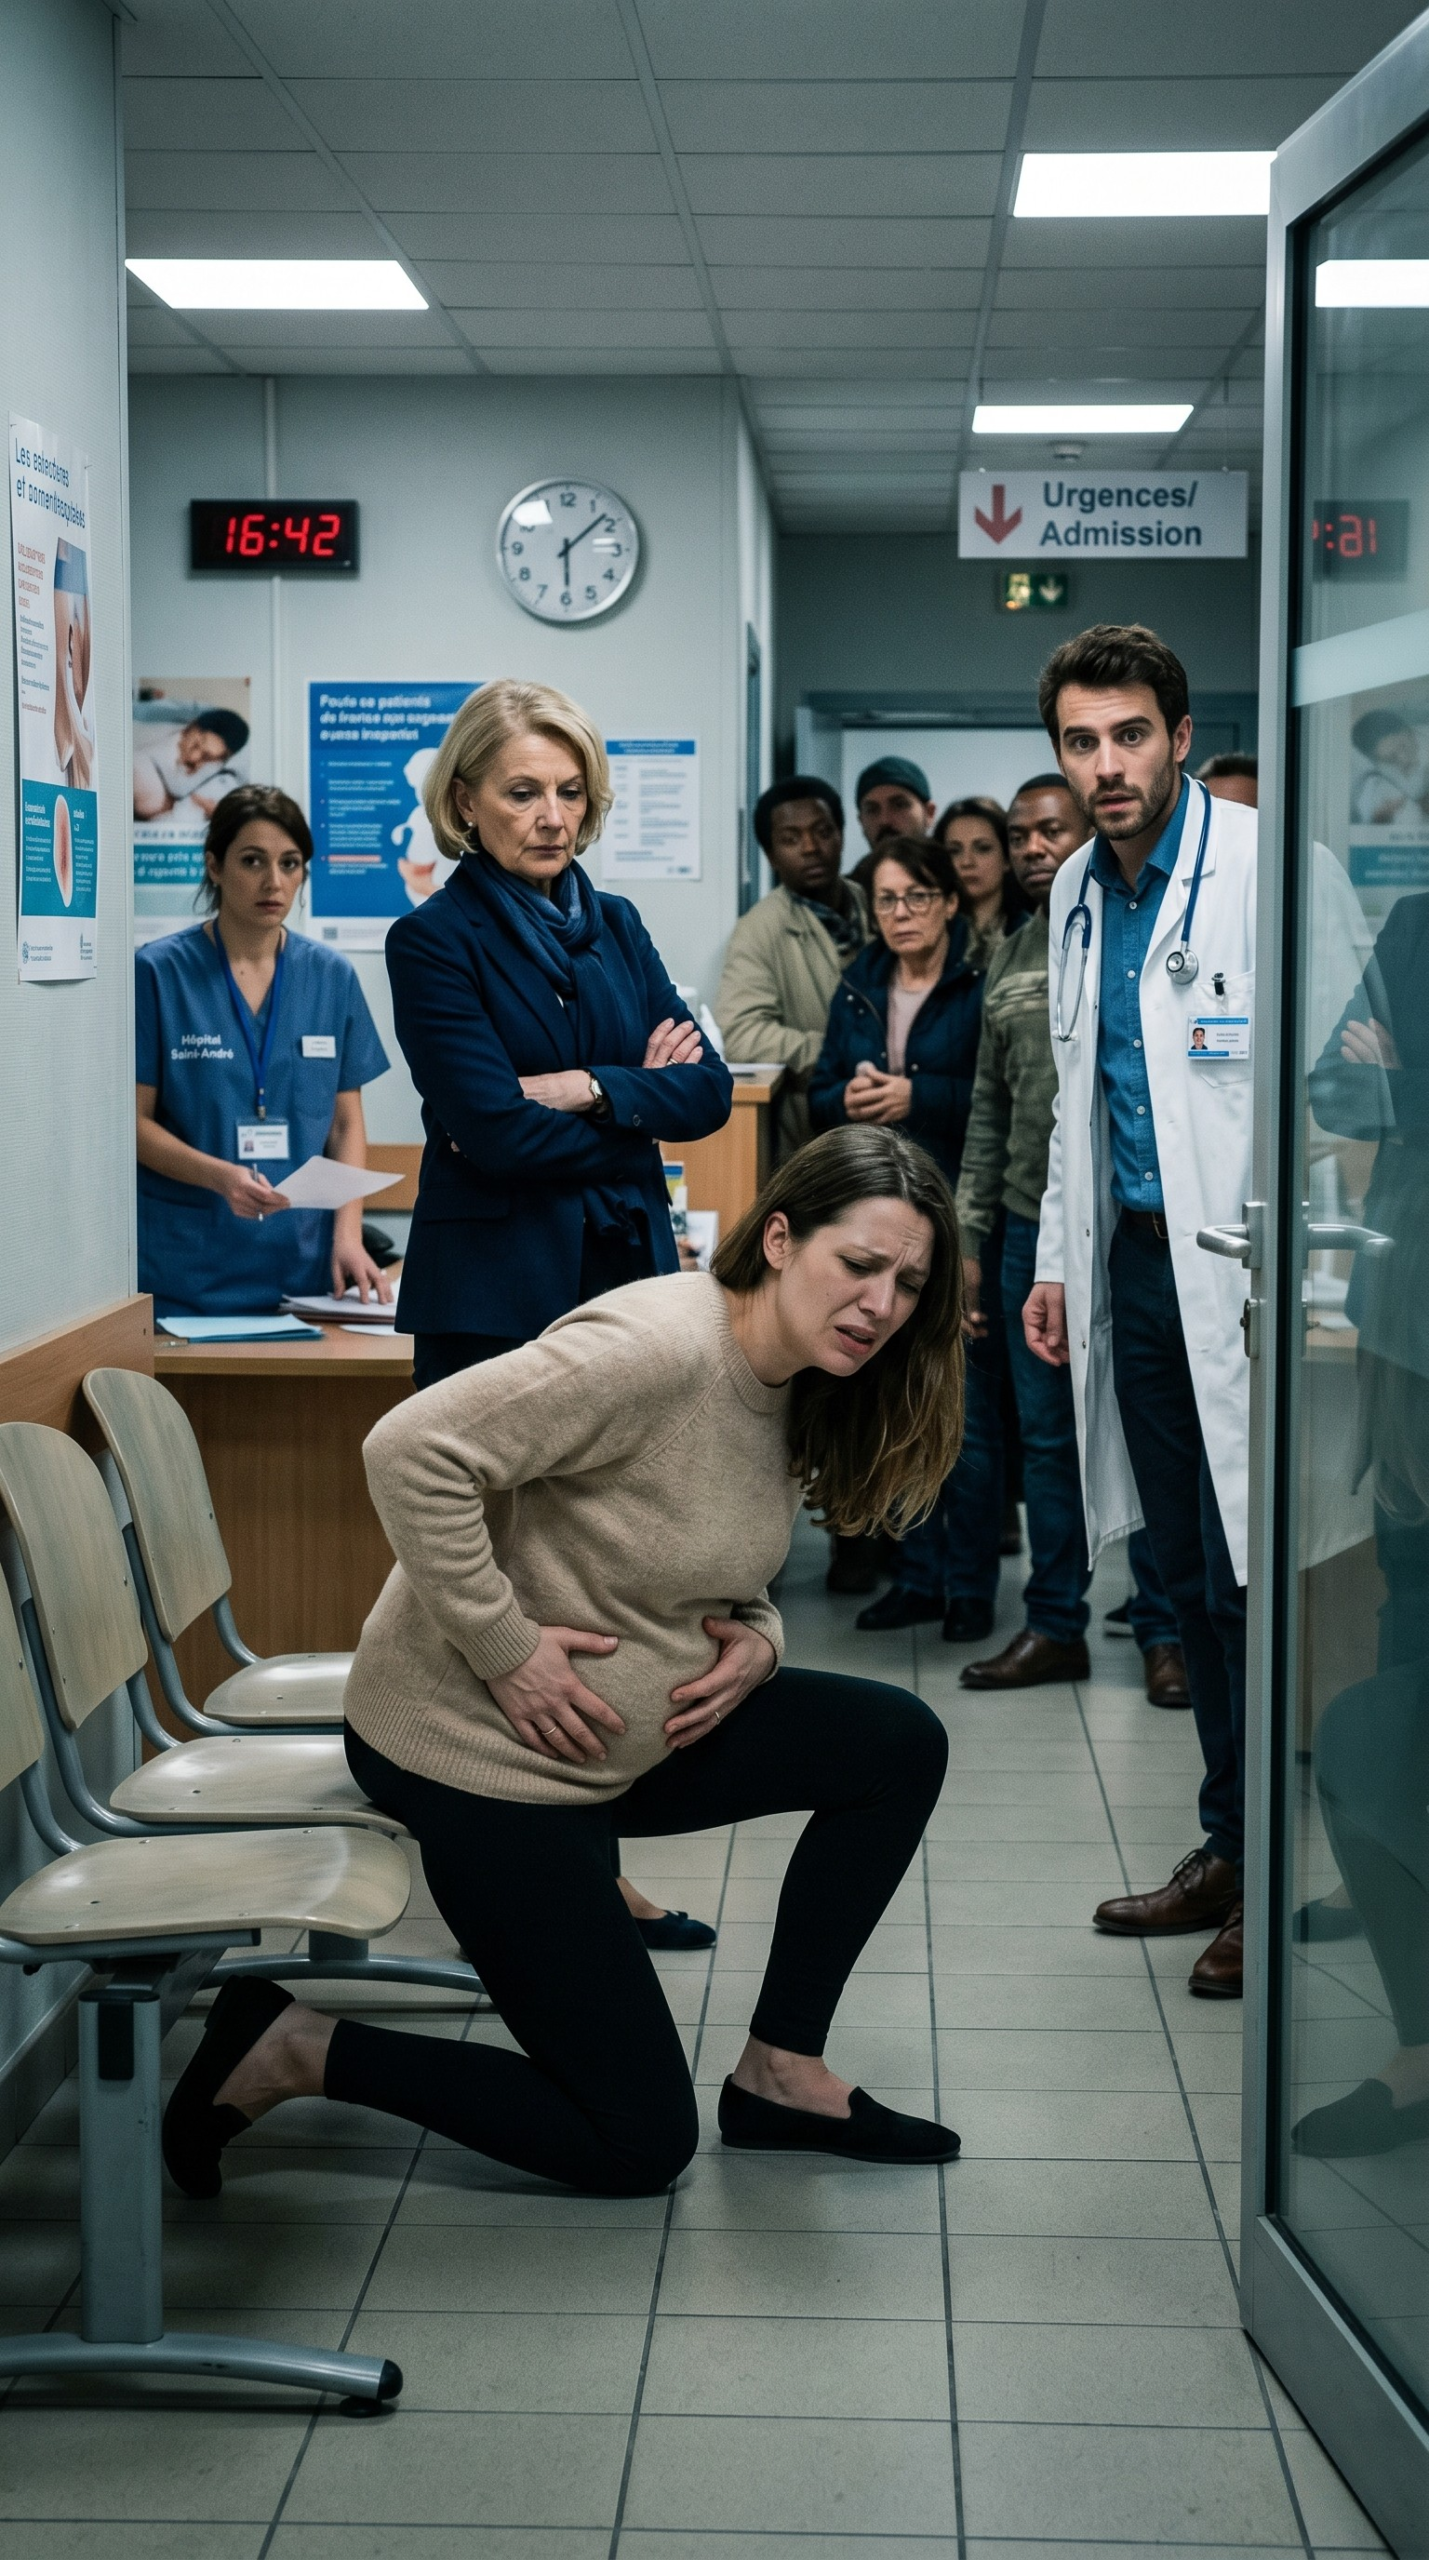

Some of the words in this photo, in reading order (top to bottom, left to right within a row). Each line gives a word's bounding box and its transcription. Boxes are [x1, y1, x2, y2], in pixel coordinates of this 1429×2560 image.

[15, 437, 31, 468] Les
[560, 492, 577, 508] 12
[1043, 480, 1199, 514] Urgences/
[604, 518, 616, 533] 2
[1040, 520, 1202, 546] Admission
[226, 514, 341, 557] 16:42
[512, 542, 524, 556] 9
[519, 566, 531, 581] 8
[603, 568, 615, 581] 4
[538, 584, 548, 598] 7
[585, 585, 596, 600] 5
[560, 592, 571, 606] 6
